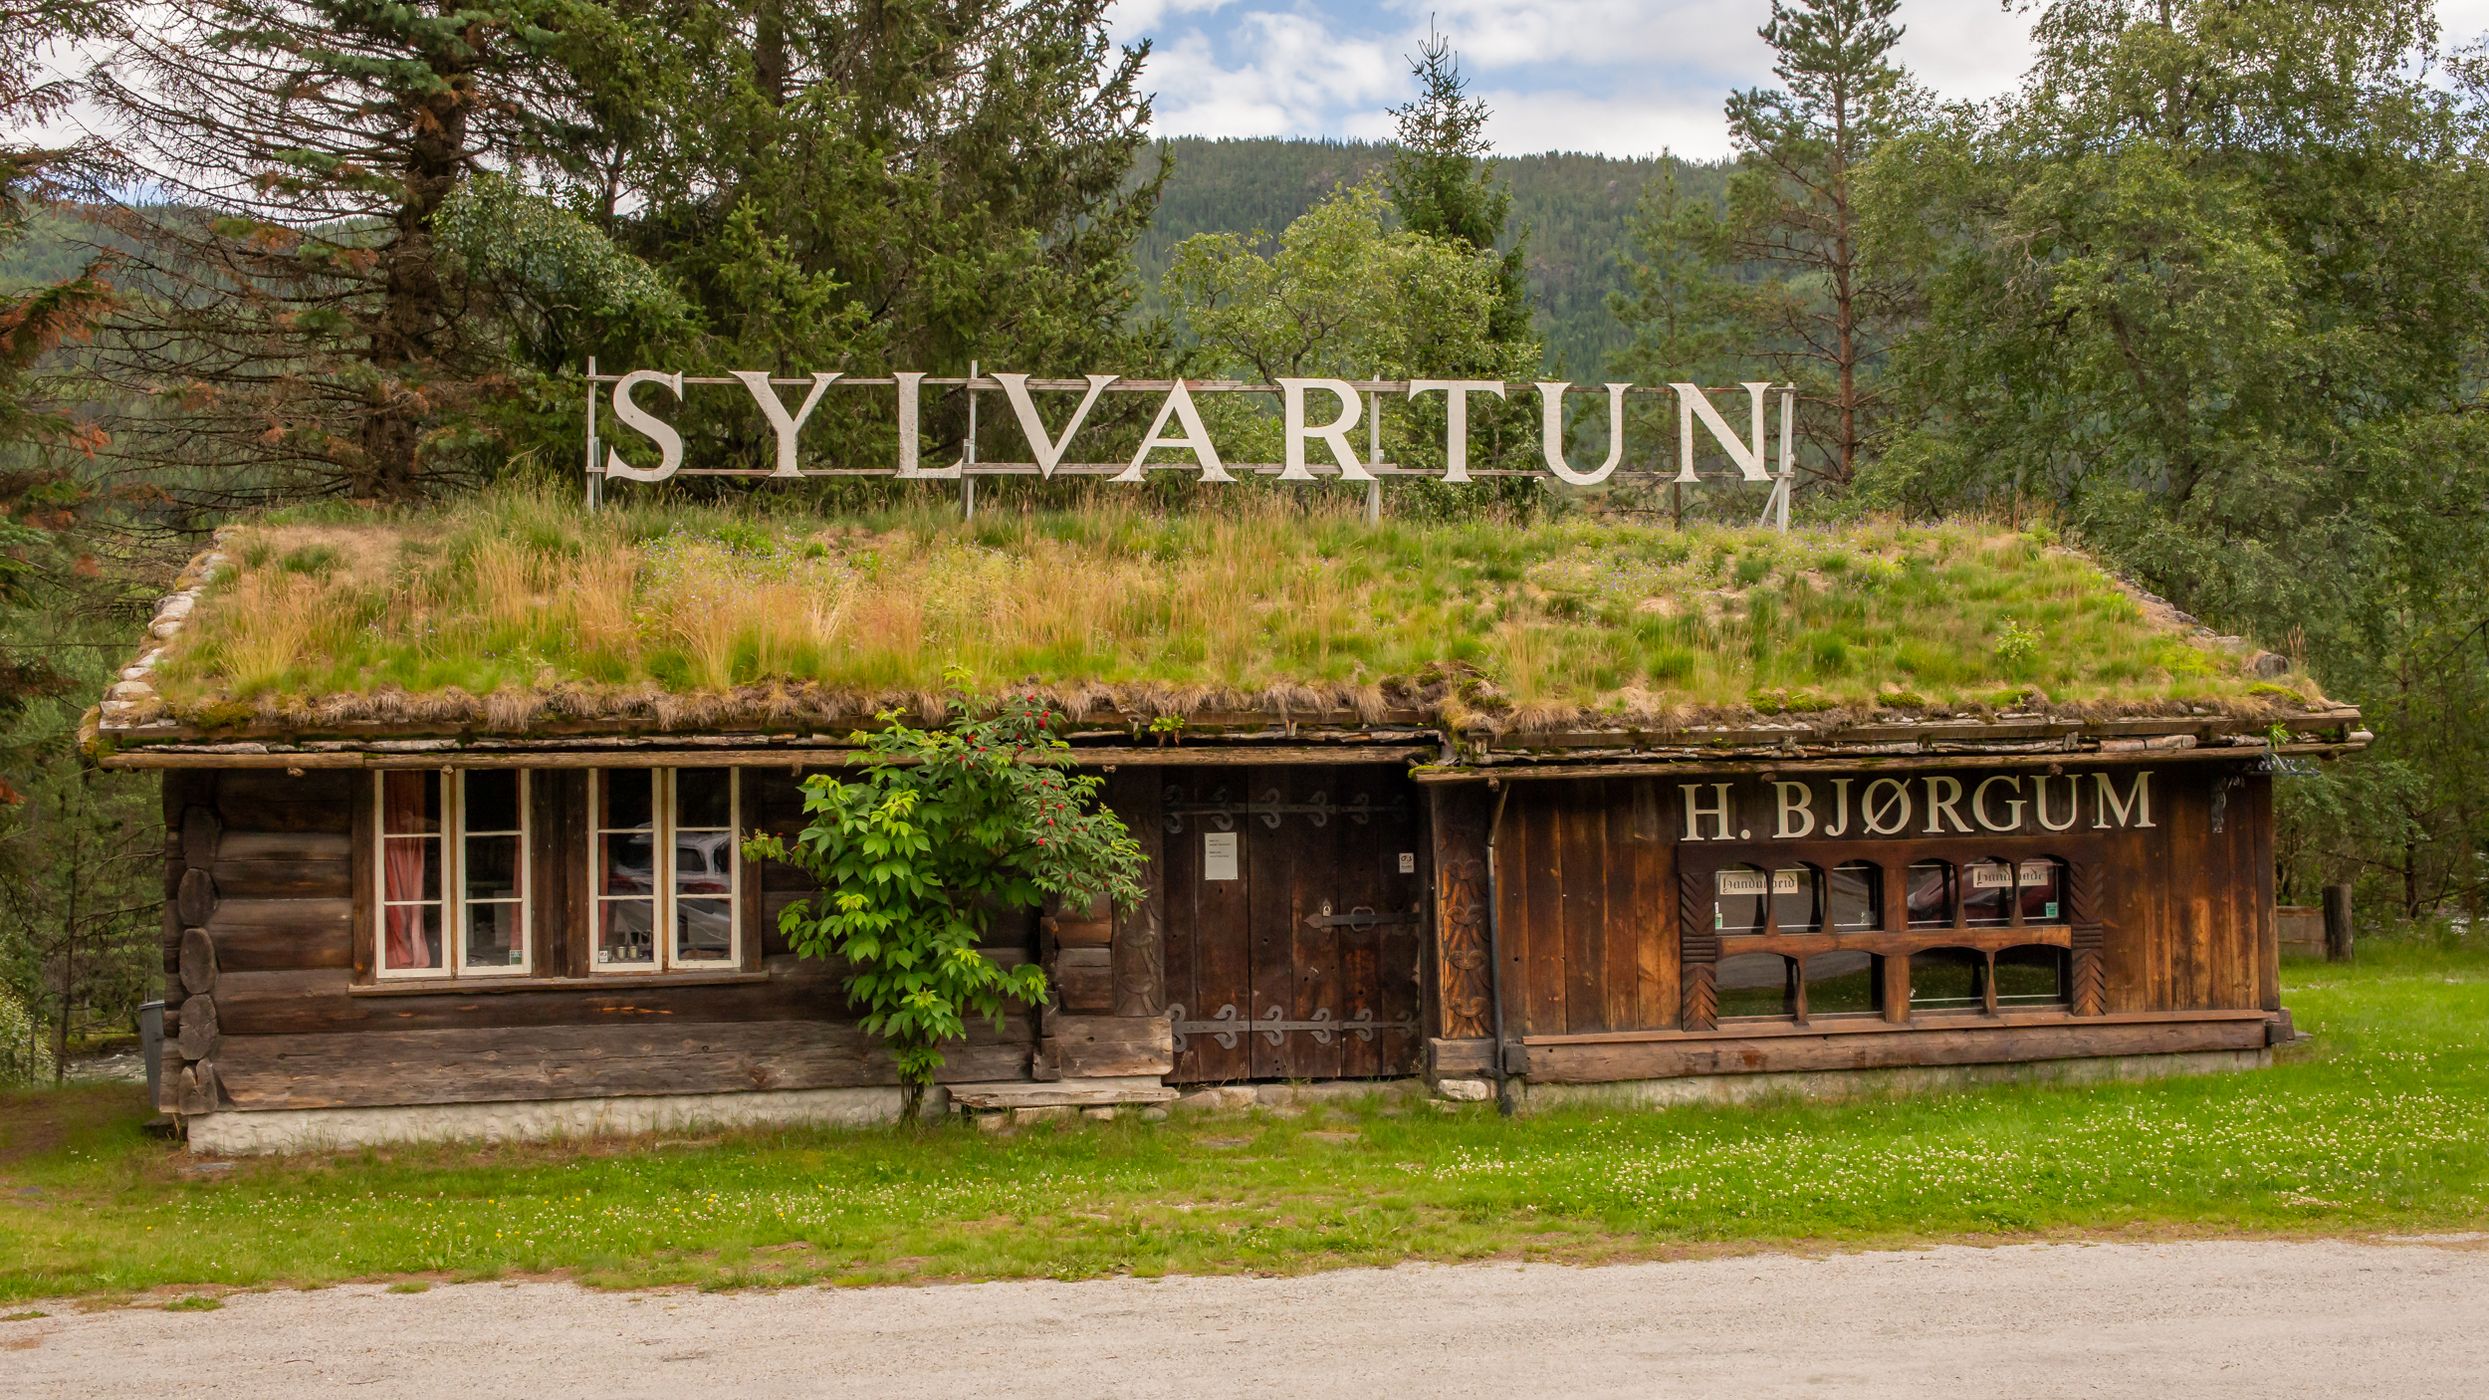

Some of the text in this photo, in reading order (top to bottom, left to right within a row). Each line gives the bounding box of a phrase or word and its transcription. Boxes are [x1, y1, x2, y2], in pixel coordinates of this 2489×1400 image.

[605, 370, 1774, 486] SYLVARTUN
[1678, 770, 2157, 841] H. BJØRGUM
